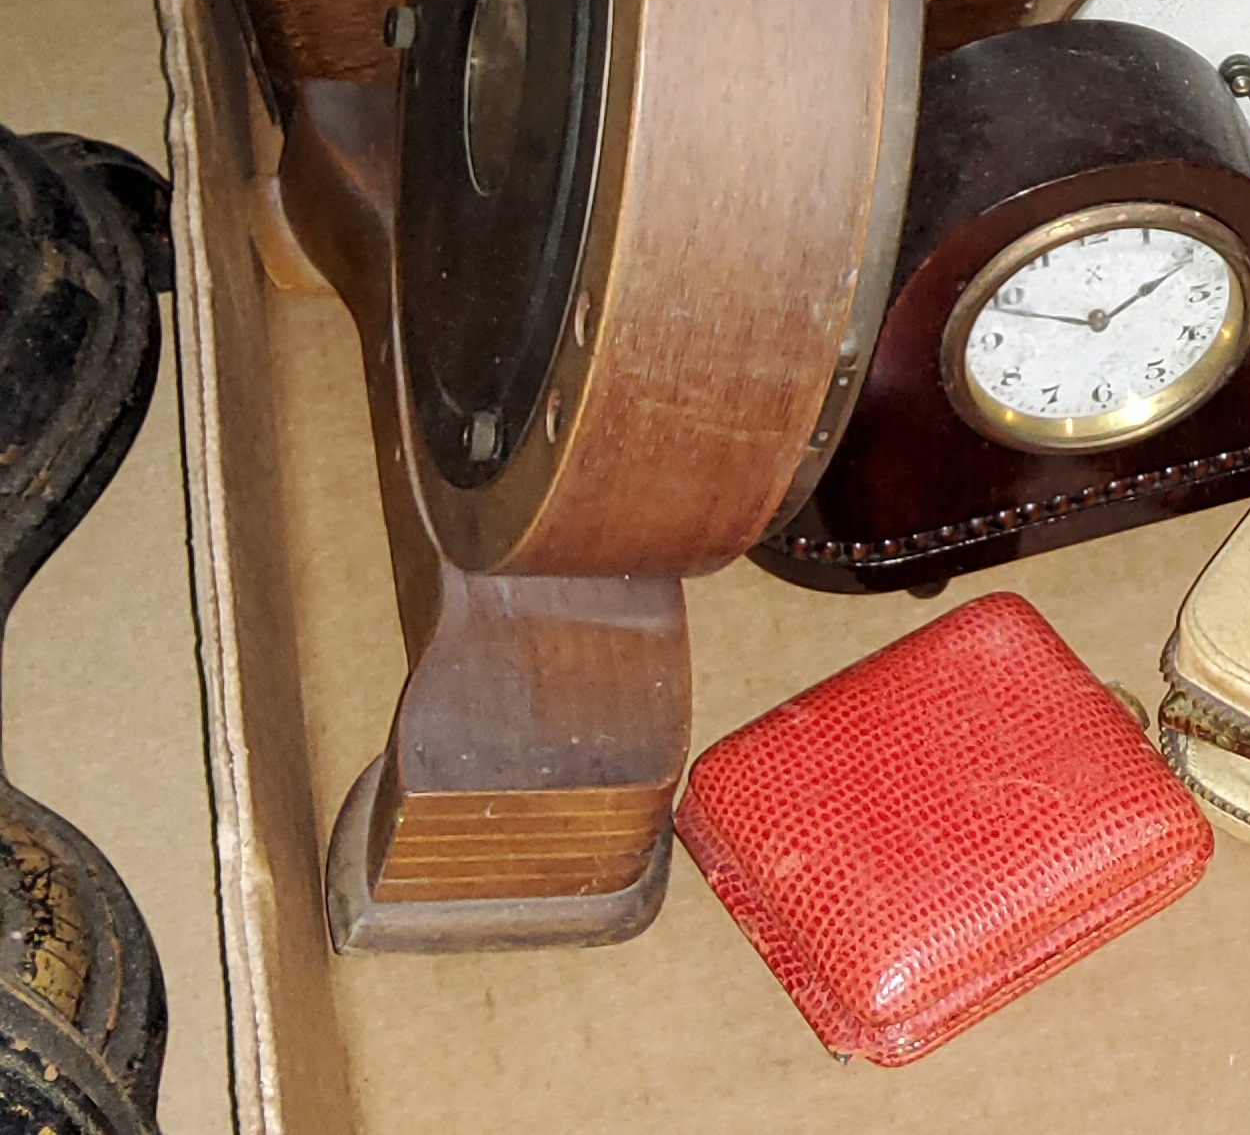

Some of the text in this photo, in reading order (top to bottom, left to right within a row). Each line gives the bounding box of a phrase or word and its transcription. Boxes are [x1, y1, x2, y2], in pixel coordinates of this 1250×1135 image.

[1188, 282, 1211, 303] 3
[980, 331, 1005, 350] 9
[1000, 365, 1022, 386] 8
[1145, 358, 1166, 381] 5
[1040, 384, 1062, 405] 7
[1091, 382, 1114, 404] 6
